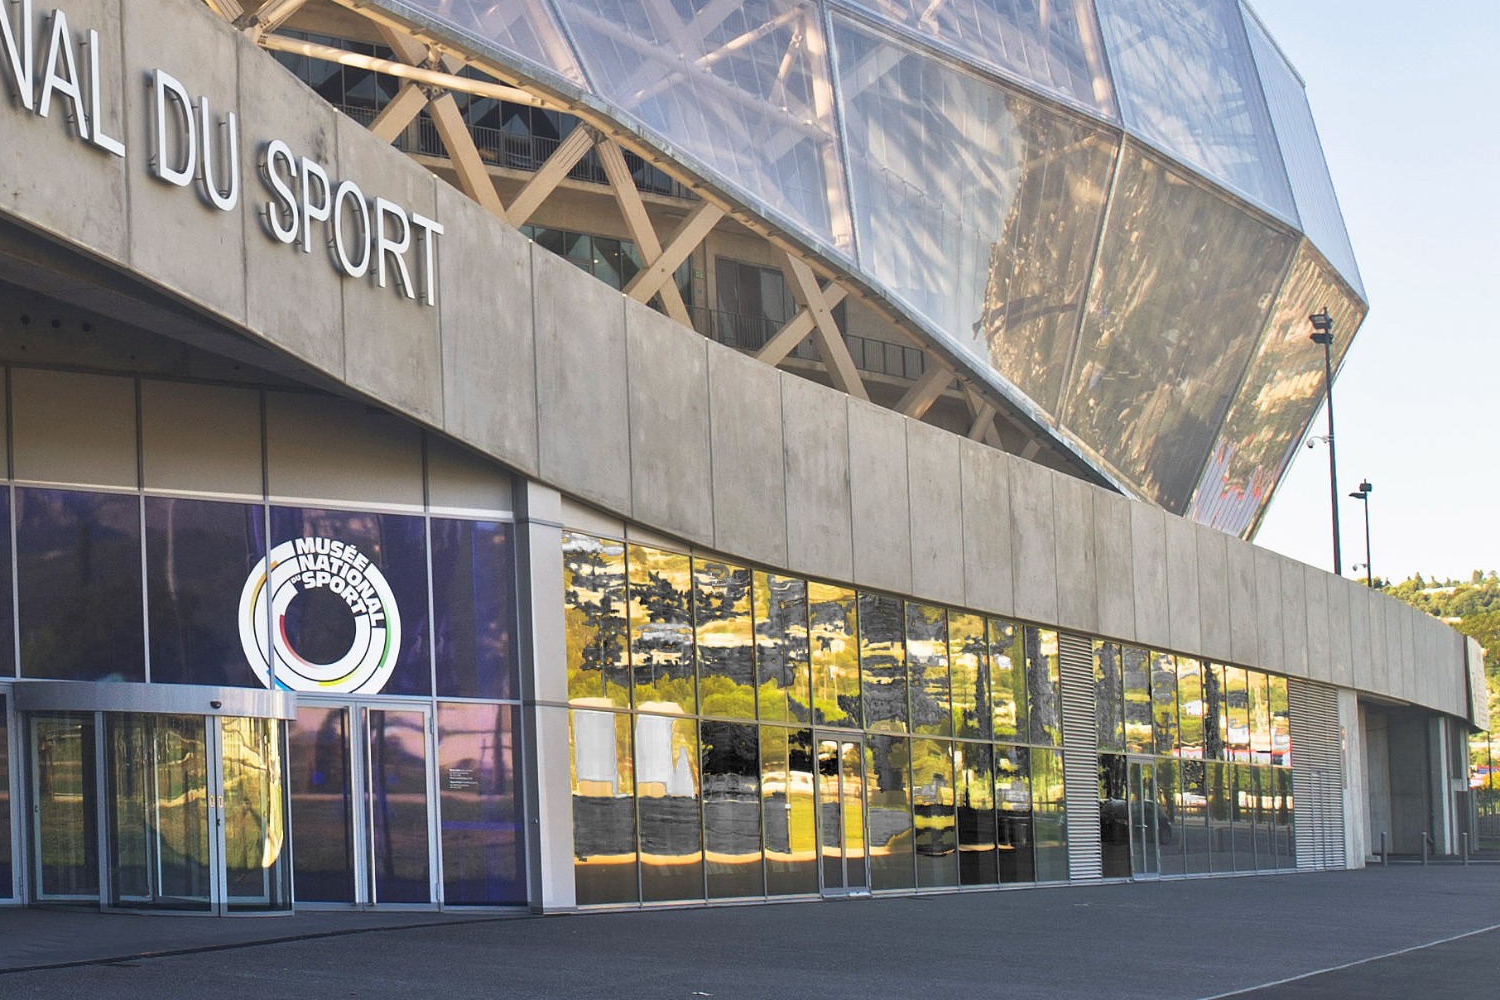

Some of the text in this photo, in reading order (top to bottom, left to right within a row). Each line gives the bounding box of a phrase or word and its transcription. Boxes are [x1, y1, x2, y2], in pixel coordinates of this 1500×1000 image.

[151, 69, 239, 212] DU
[264, 139, 444, 307] SPORT
[295, 536, 369, 572] MUSÉE
[290, 572, 367, 614] DU SPORT
[298, 553, 386, 627] NATIONAL
